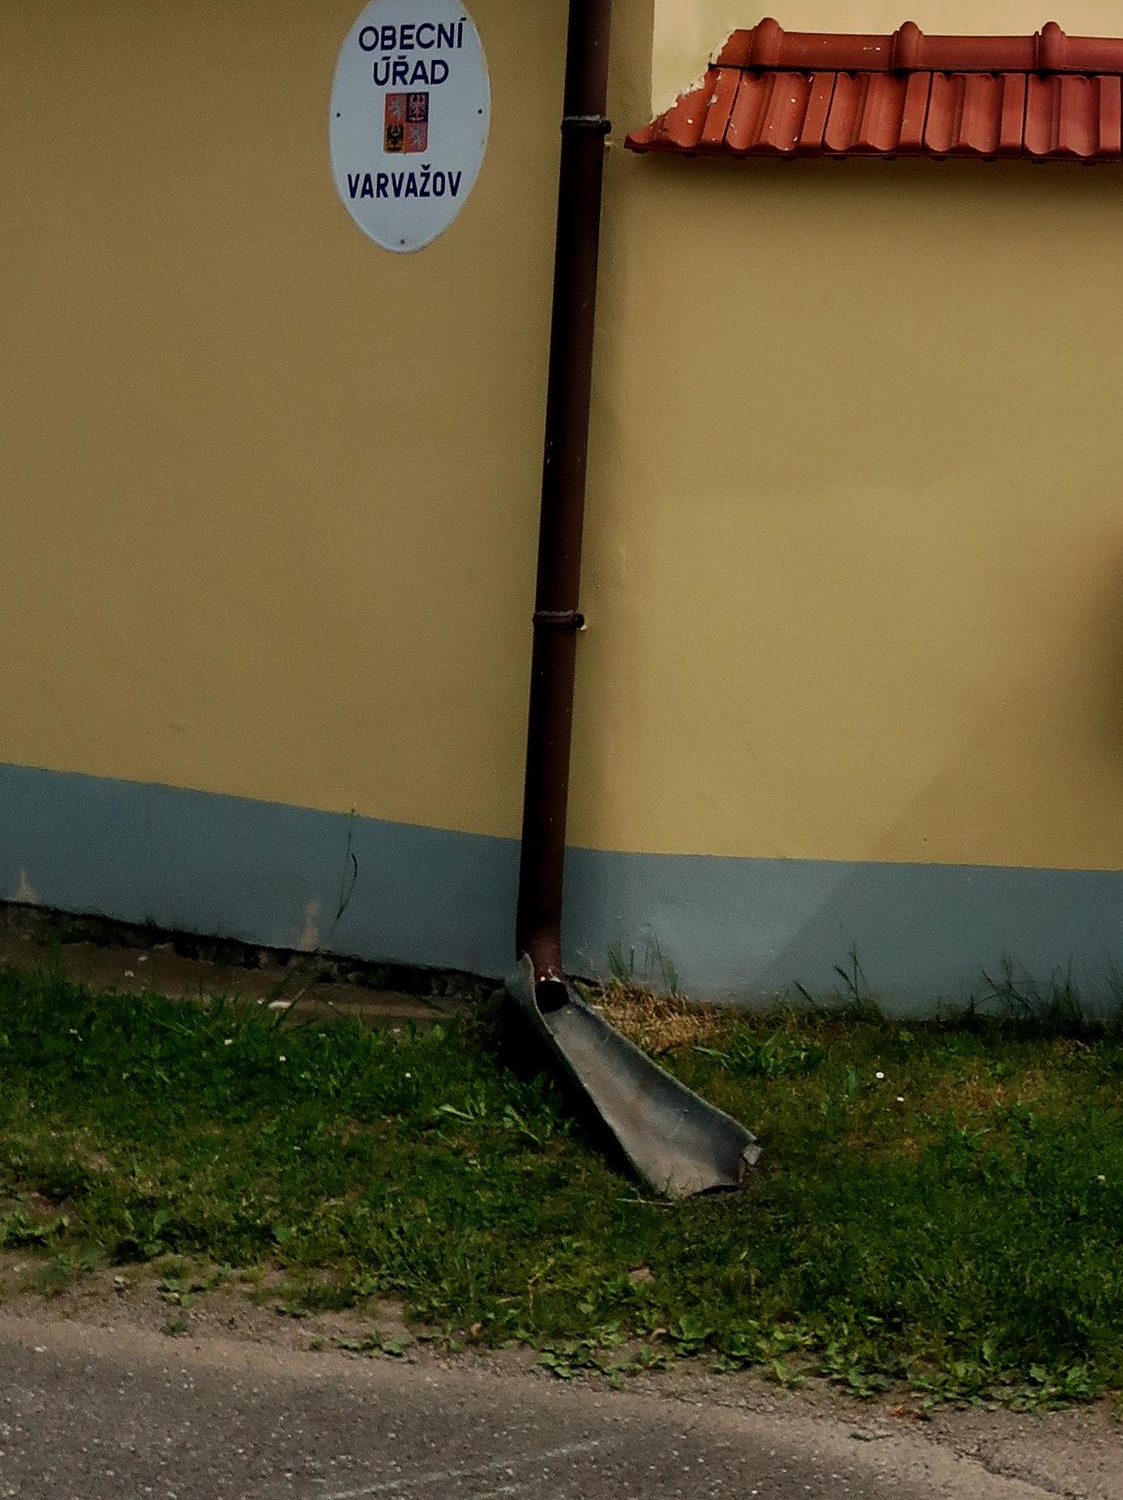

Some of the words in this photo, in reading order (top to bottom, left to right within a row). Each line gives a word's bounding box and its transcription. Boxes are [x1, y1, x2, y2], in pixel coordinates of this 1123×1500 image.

[358, 17, 468, 52] OBECNÍ
[373, 55, 450, 87] ÚŘAD
[347, 164, 463, 199] VARVAŽOV
